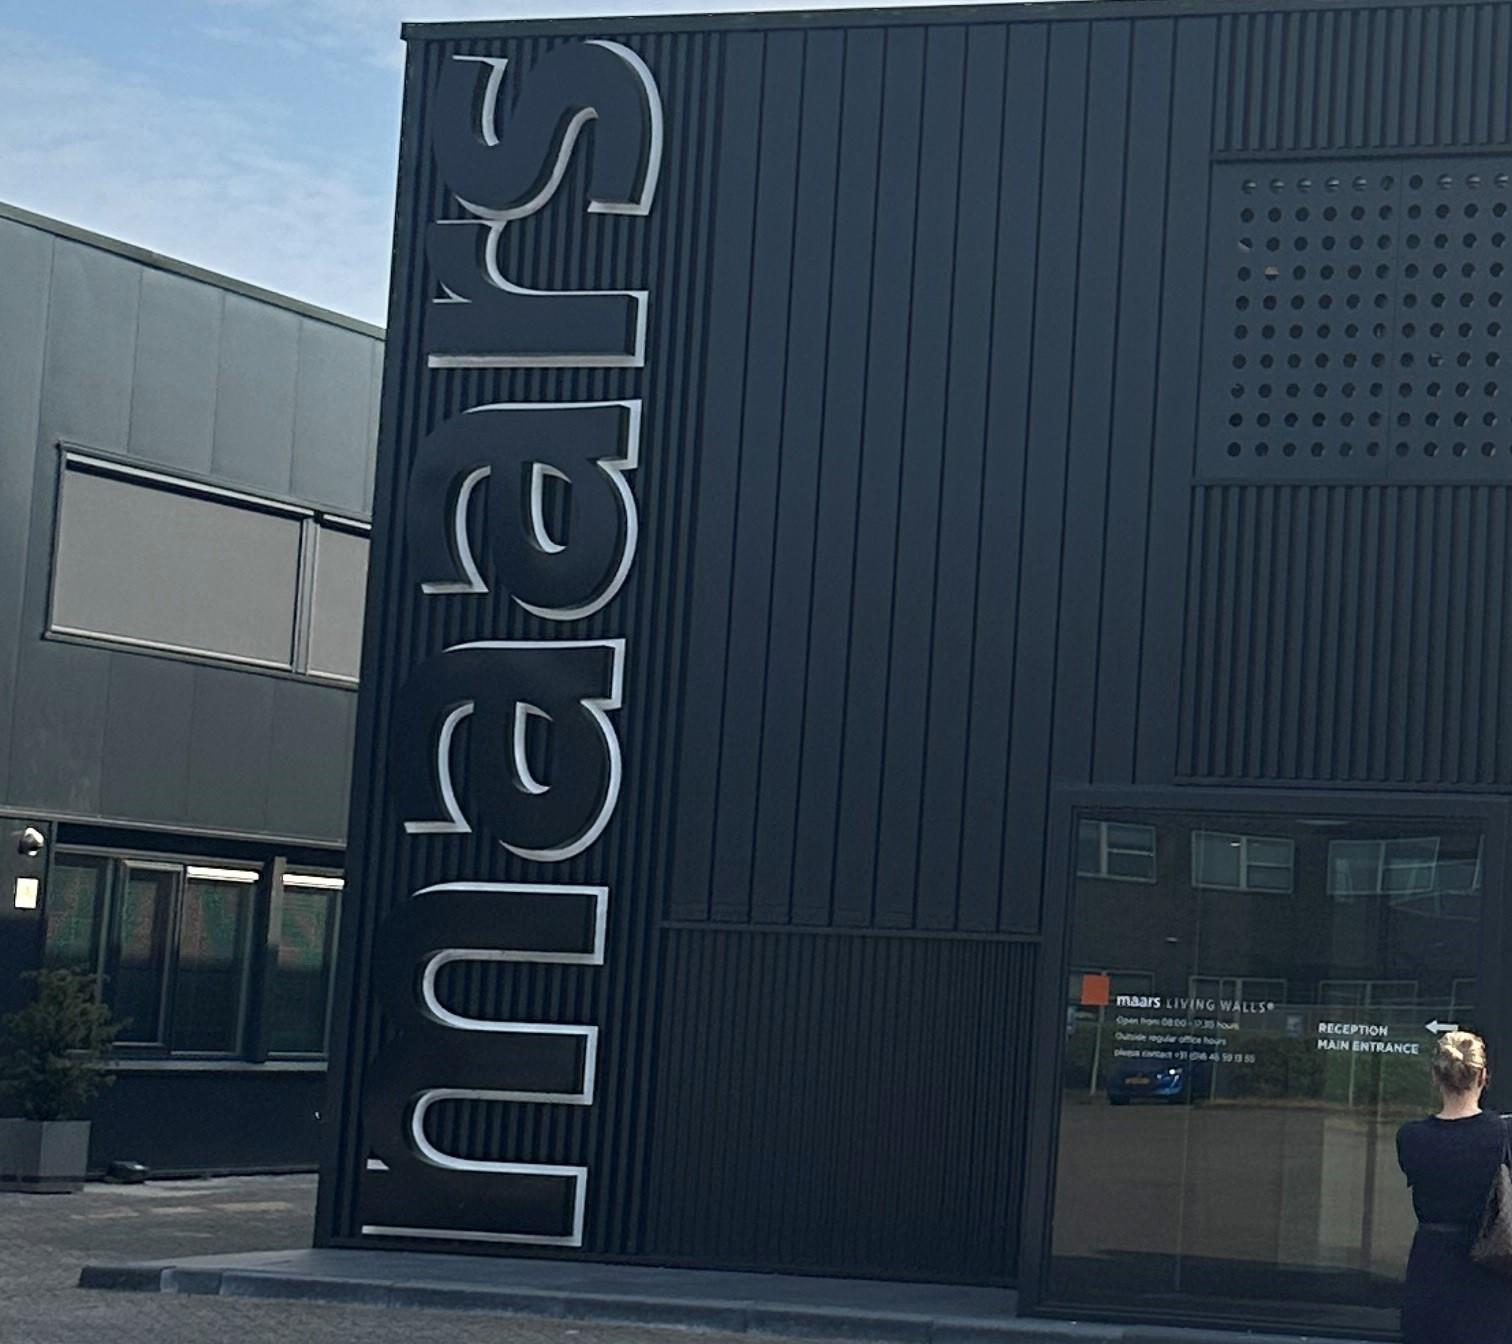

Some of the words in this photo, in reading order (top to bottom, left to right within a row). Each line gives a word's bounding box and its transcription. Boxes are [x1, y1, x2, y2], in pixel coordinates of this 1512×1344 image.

[361, 38, 665, 1248] maars
[1115, 995, 1161, 1009] maars
[1166, 997, 1215, 1011] LIVING
[1115, 1015, 1138, 1026] Open
[1216, 1020, 1240, 1030] hours
[1318, 1022, 1389, 1037] RECEPTION
[1114, 1031, 1146, 1041] Outside
[1148, 1034, 1177, 1044] regular
[1178, 1034, 1202, 1044] office
[1202, 1036, 1227, 1046] hours
[1317, 1039, 1350, 1051] MAIN
[1351, 1040, 1420, 1055] ENTRANCE
